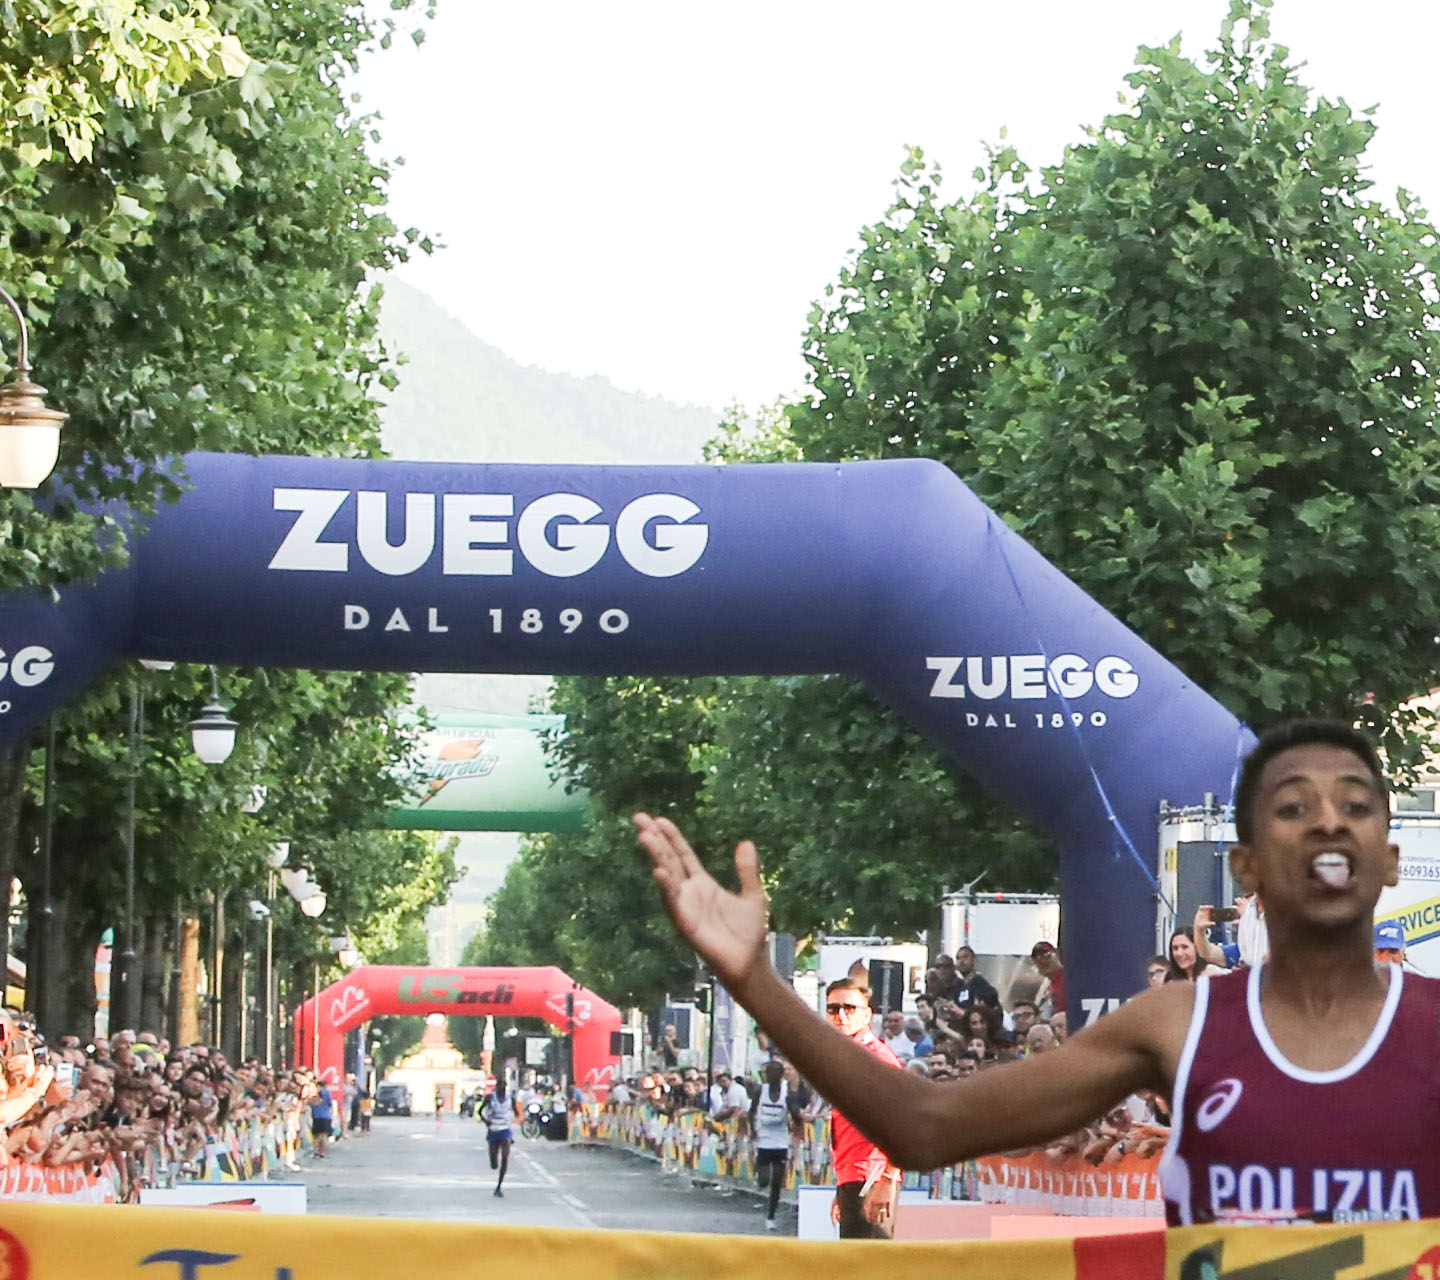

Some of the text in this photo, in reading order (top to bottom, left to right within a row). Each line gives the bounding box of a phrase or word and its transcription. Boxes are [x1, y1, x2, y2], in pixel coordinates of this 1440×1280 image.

[268, 487, 710, 578] ZUEGG
[343, 603, 630, 635] DAL 1890
[926, 653, 1140, 701] ZUEGG
[965, 710, 1108, 729] DAL 1890
[1208, 1163, 1420, 1221] POLIZIA
